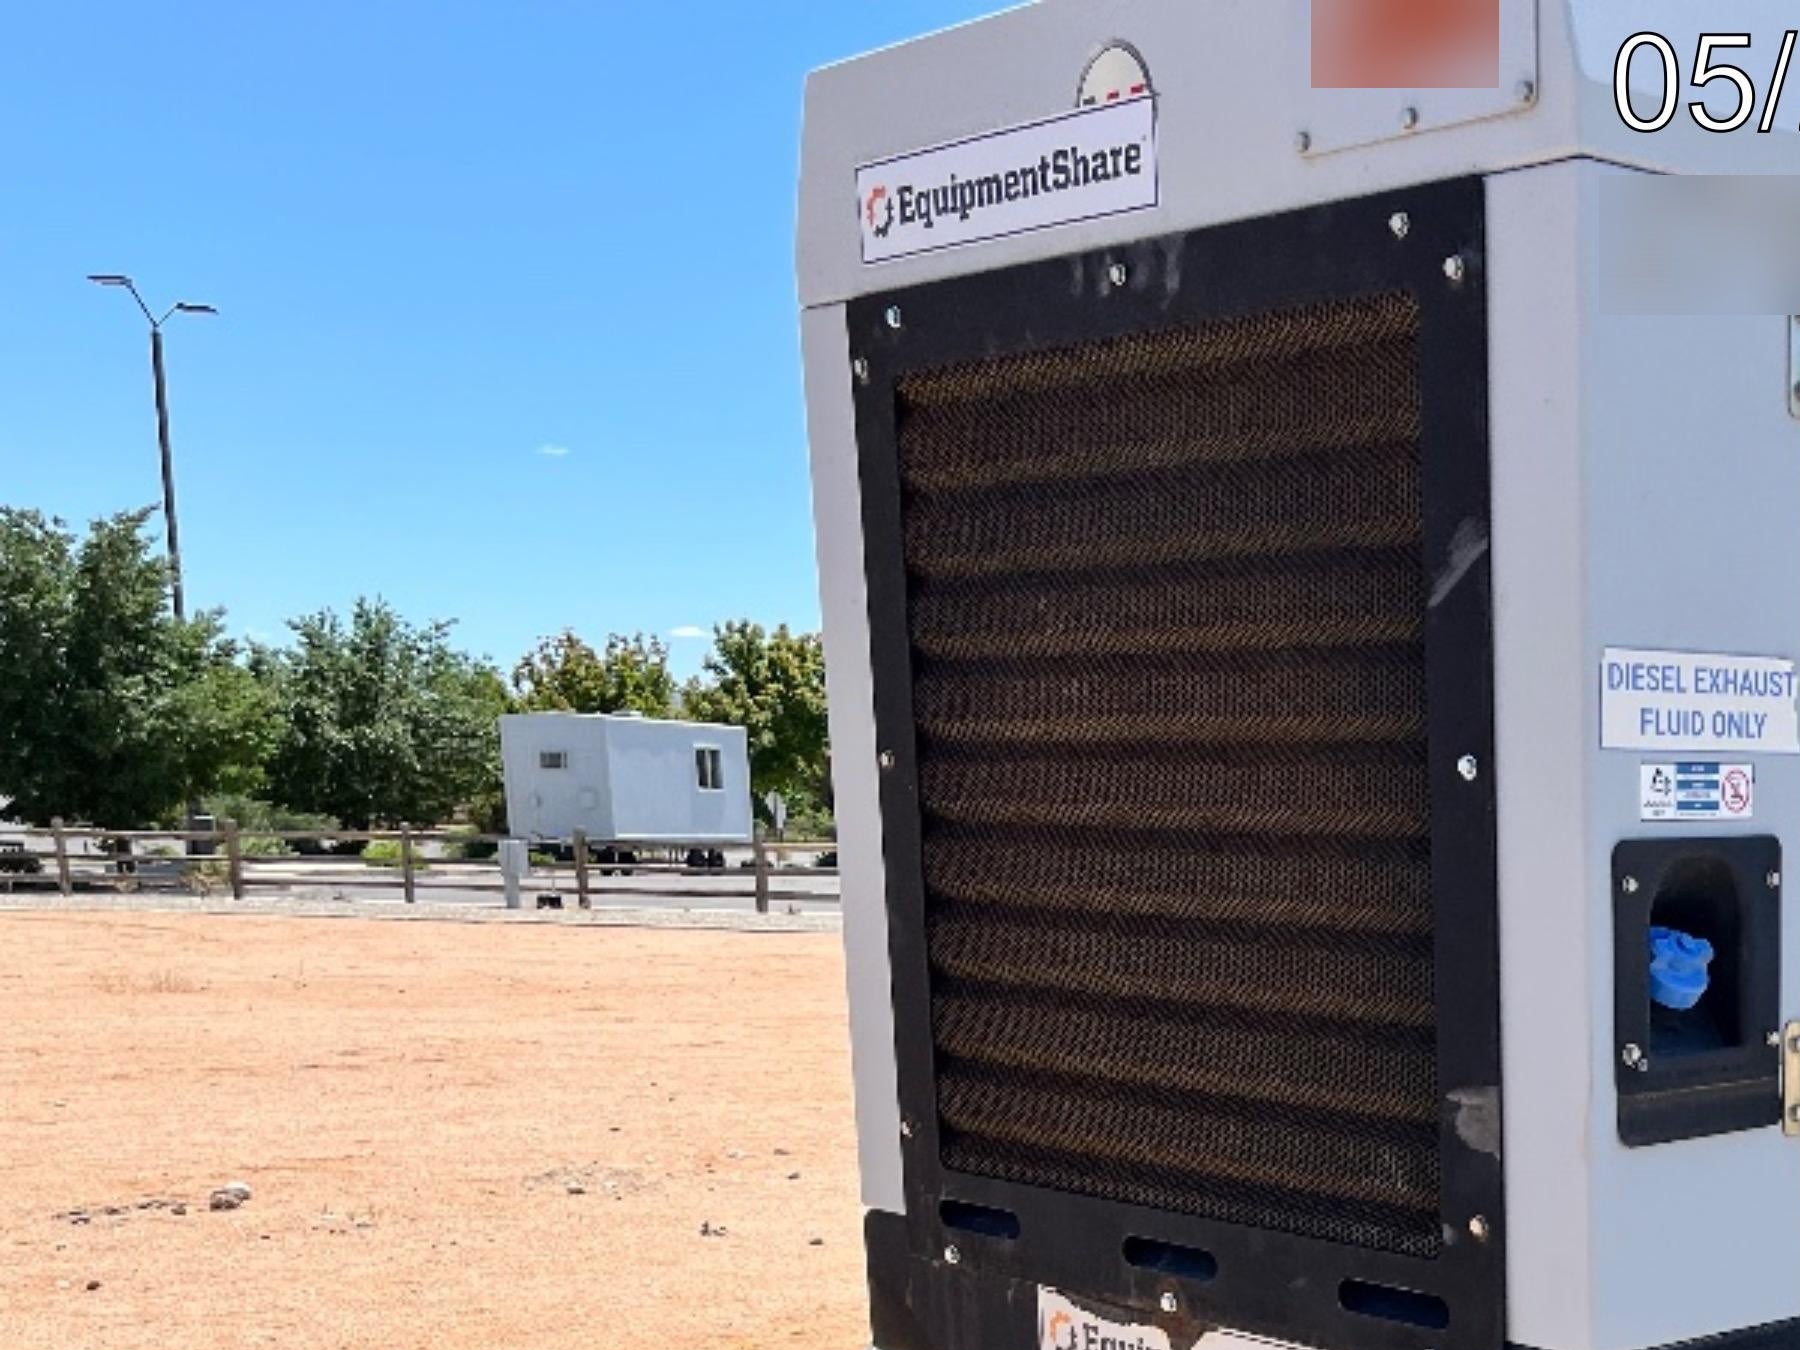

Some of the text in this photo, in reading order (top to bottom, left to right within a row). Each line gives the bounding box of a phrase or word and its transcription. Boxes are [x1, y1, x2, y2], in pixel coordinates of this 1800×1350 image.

[897, 142, 1142, 228] EquipmentShare
[1607, 662, 1796, 697] DIESEL EXHAUST
[1640, 707, 1768, 739] FLUID ONLY
